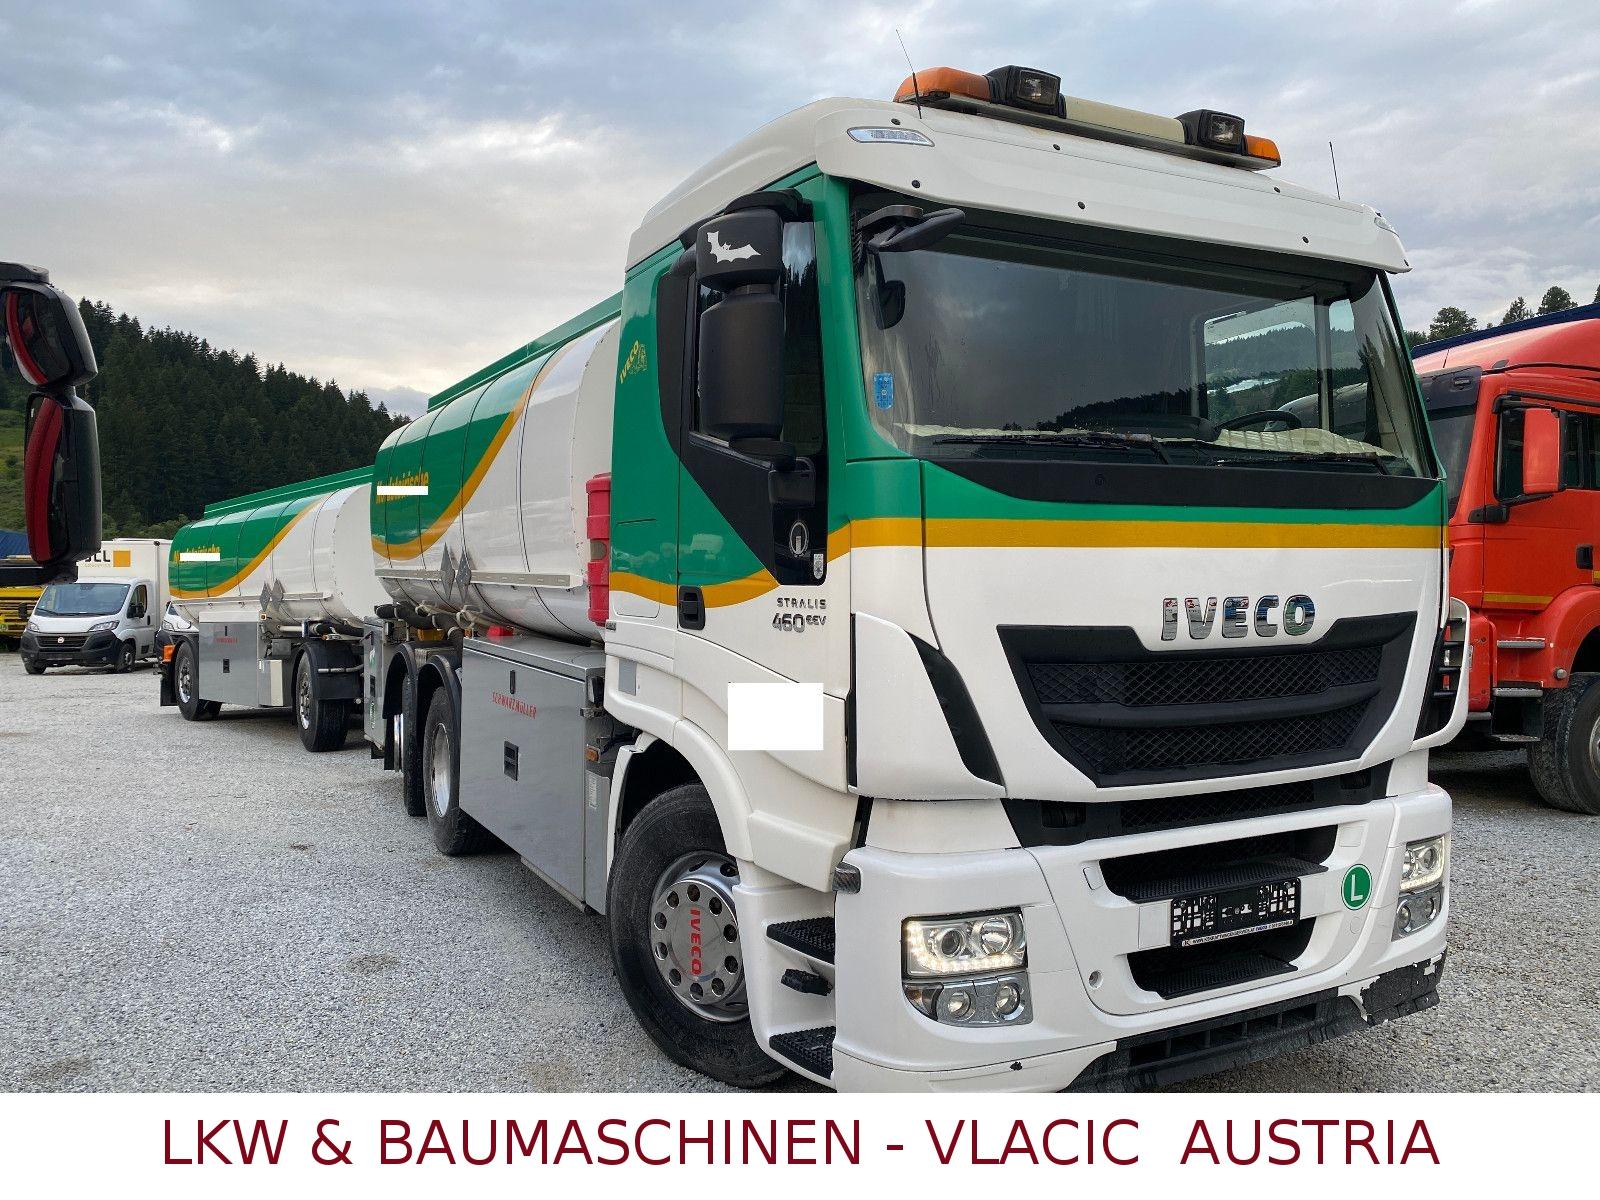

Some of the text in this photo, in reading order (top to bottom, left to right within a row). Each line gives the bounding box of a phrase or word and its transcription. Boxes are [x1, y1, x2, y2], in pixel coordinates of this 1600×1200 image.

[777, 597, 826, 609] STRALIS
[1161, 594, 1316, 641] IVECO
[772, 612, 805, 633] 460
[1349, 873, 1364, 902] L
[689, 908, 702, 976] IVECO
